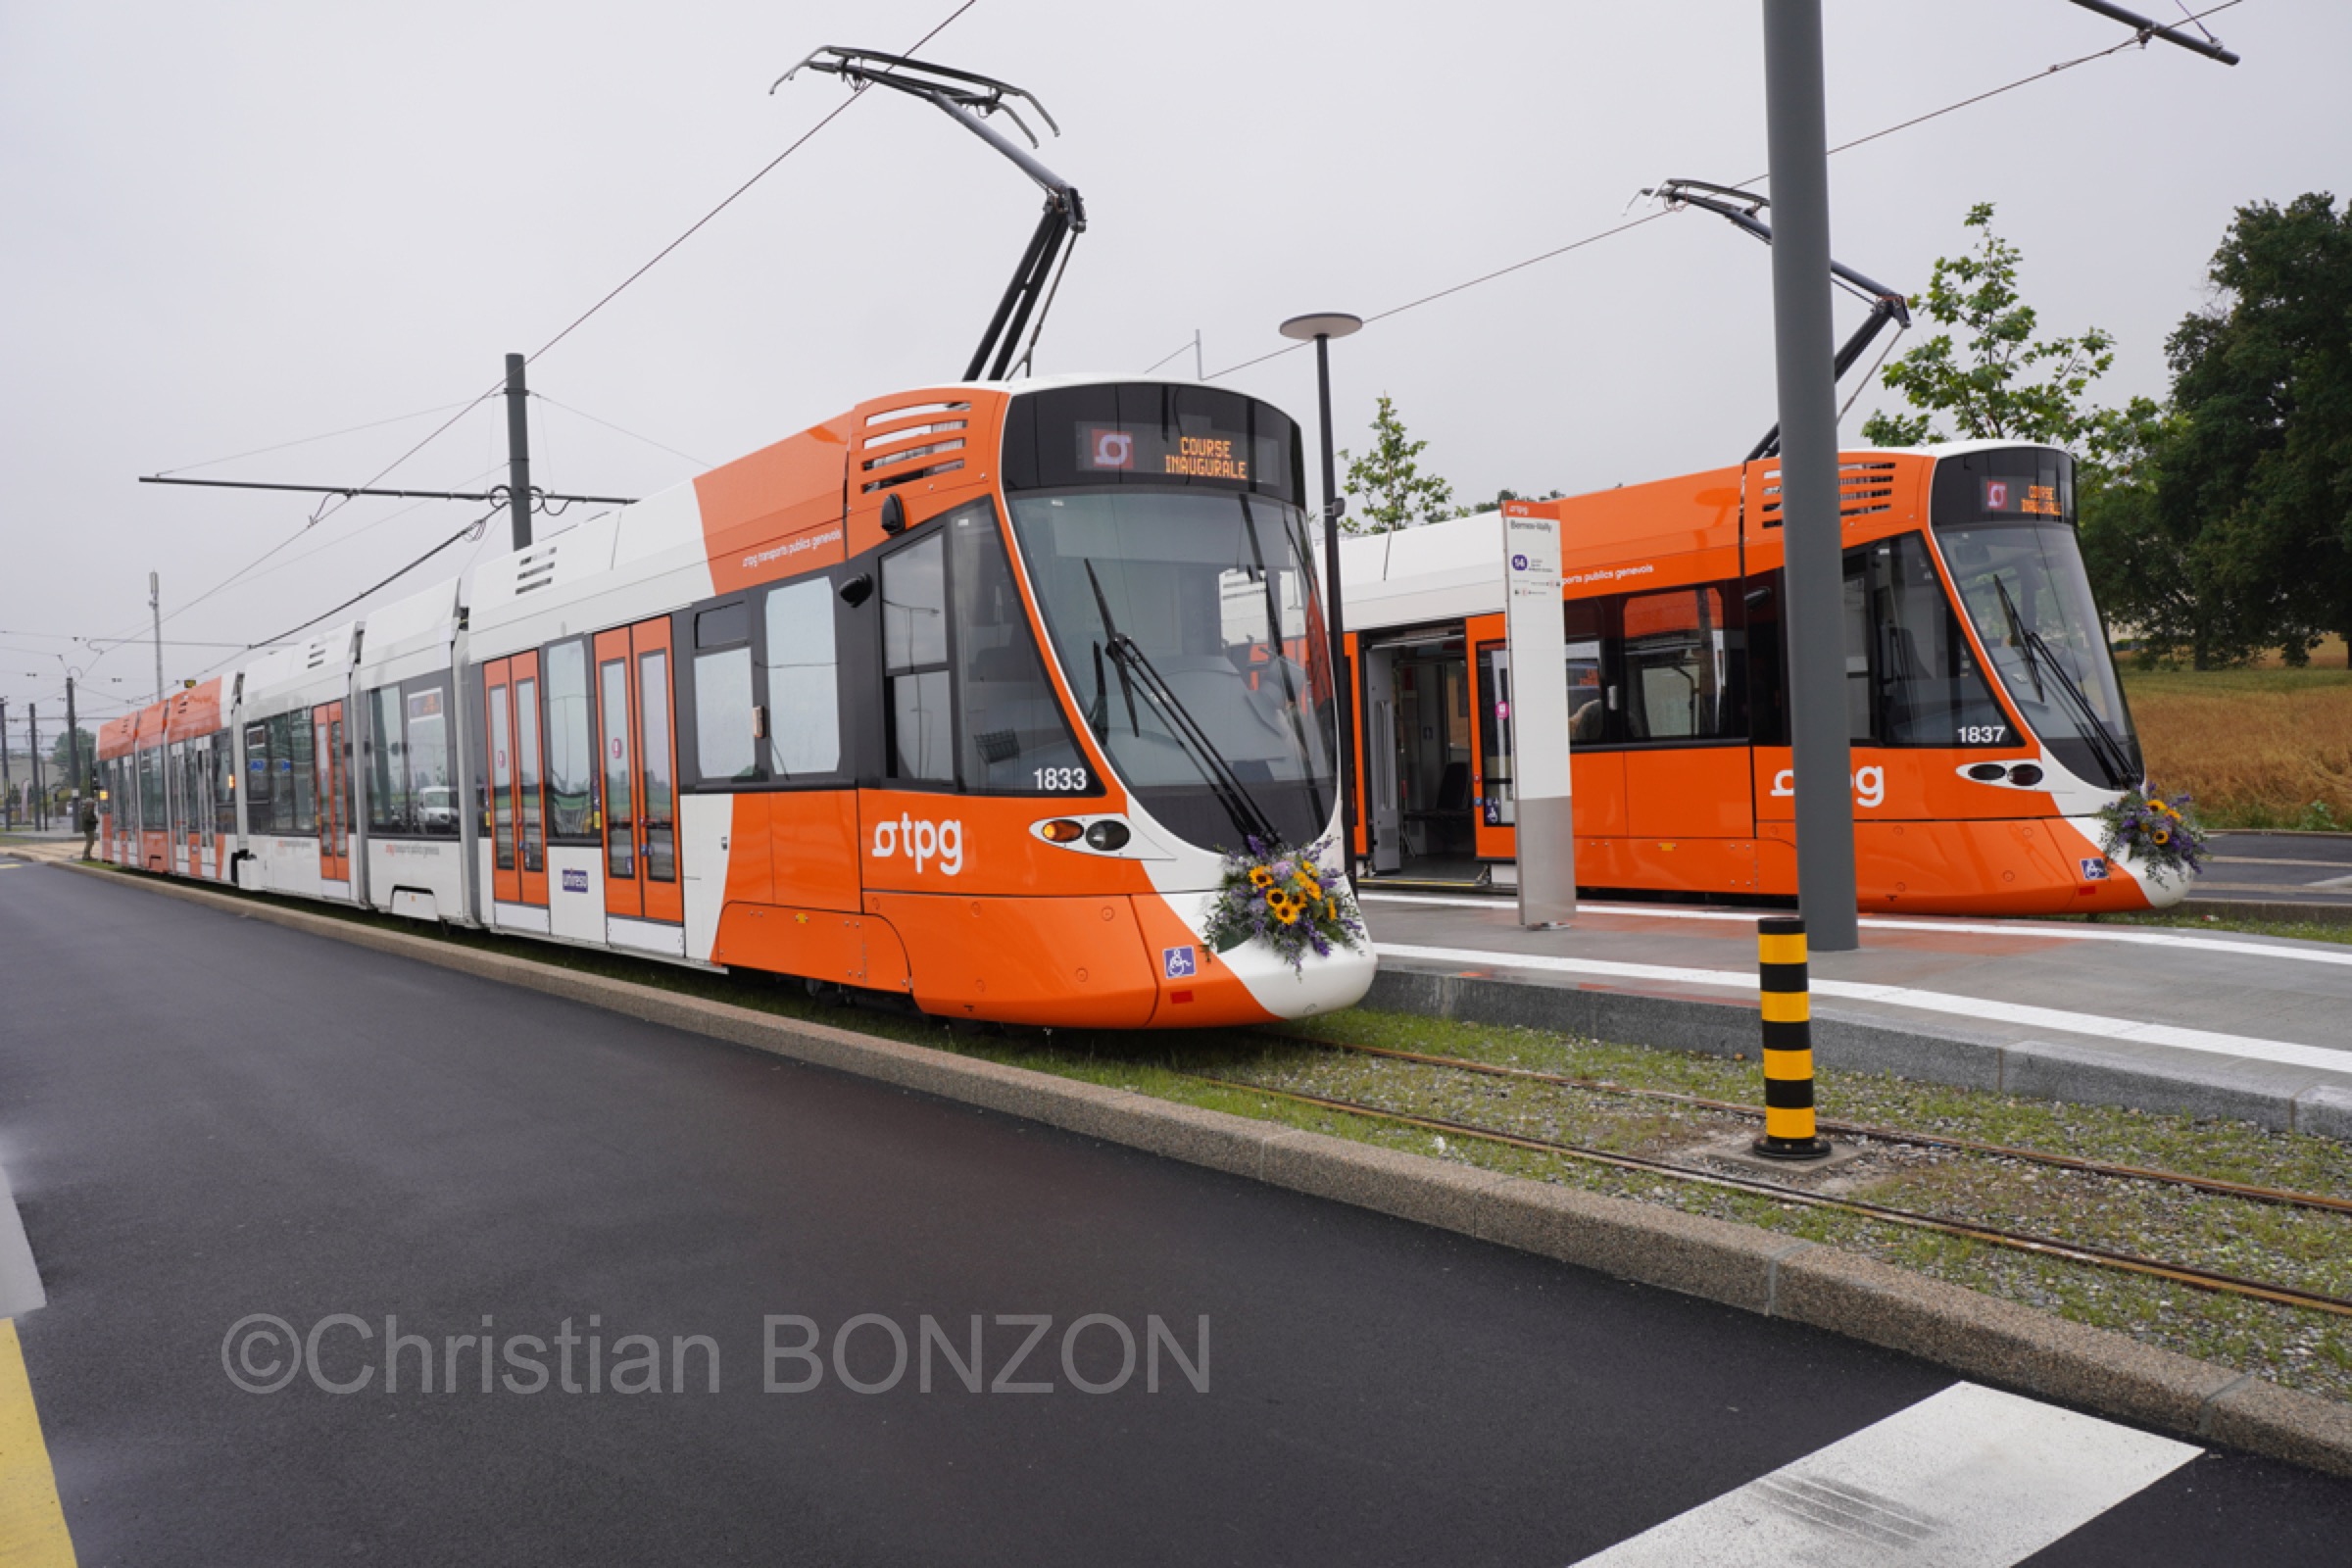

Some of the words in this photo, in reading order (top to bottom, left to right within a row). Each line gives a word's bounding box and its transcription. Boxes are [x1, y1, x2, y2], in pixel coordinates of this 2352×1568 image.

[1180, 437, 1232, 460] COURSE
[1165, 455, 1248, 479] INAUGURALE
[1957, 725, 2006, 744] 1837
[1032, 767, 1087, 791] 1833
